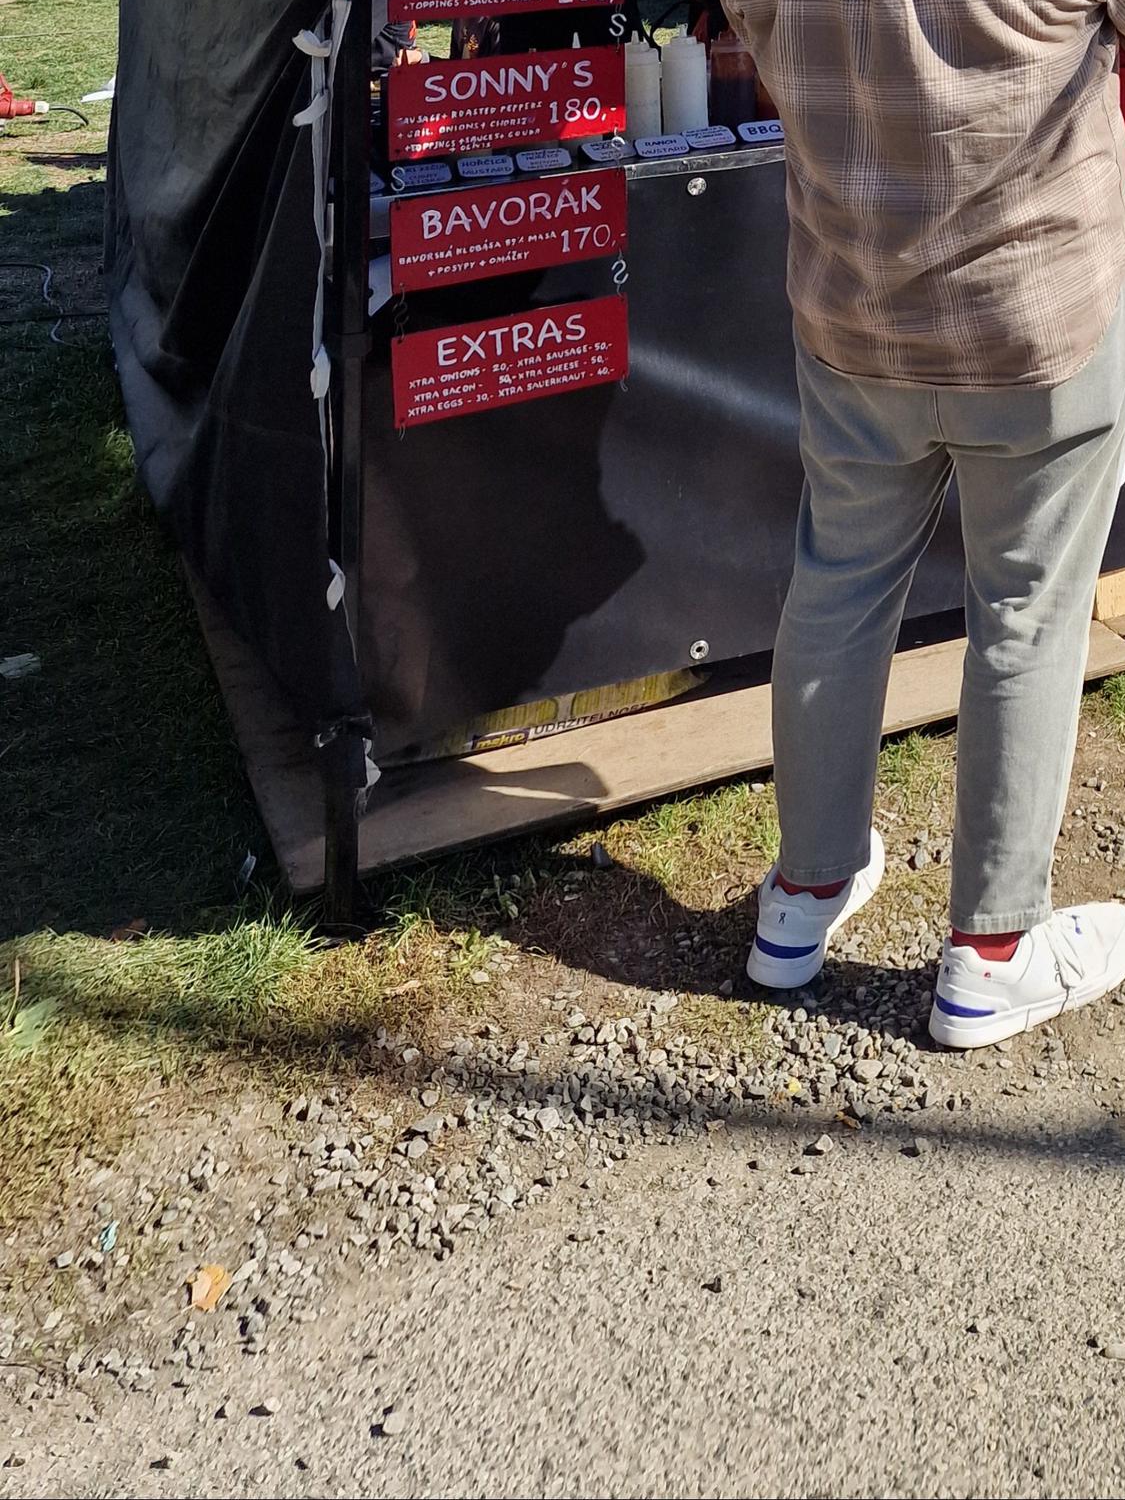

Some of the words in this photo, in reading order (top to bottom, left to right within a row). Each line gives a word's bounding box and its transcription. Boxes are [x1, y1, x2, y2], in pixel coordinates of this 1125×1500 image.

[424, 60, 594, 103] SONNY'S
[451, 107, 497, 119] ROASTED
[500, 101, 543, 113] PEPPERS
[507, 128, 541, 138] GOUDA
[747, 124, 782, 135] BBQ
[641, 145, 687, 154] MUSTARD
[462, 166, 512, 175] MUSTARD
[421, 179, 601, 239] BAVORÁK
[437, 314, 585, 366] EXTRAS
[409, 375, 435, 389] XTRA
[440, 367, 480, 381] ONIONS
[517, 355, 541, 368] XTRA
[414, 391, 439, 402] XTRA
[443, 383, 476, 396] BACON
[519, 369, 542, 380] XTRA
[547, 361, 580, 374] CHEESE
[408, 405, 434, 417] XTRA
[437, 398, 463, 410] EGGS
[499, 386, 523, 398] XTRA
[527, 371, 586, 392] SAUERKRAUT
[476, 732, 525, 749] makro
